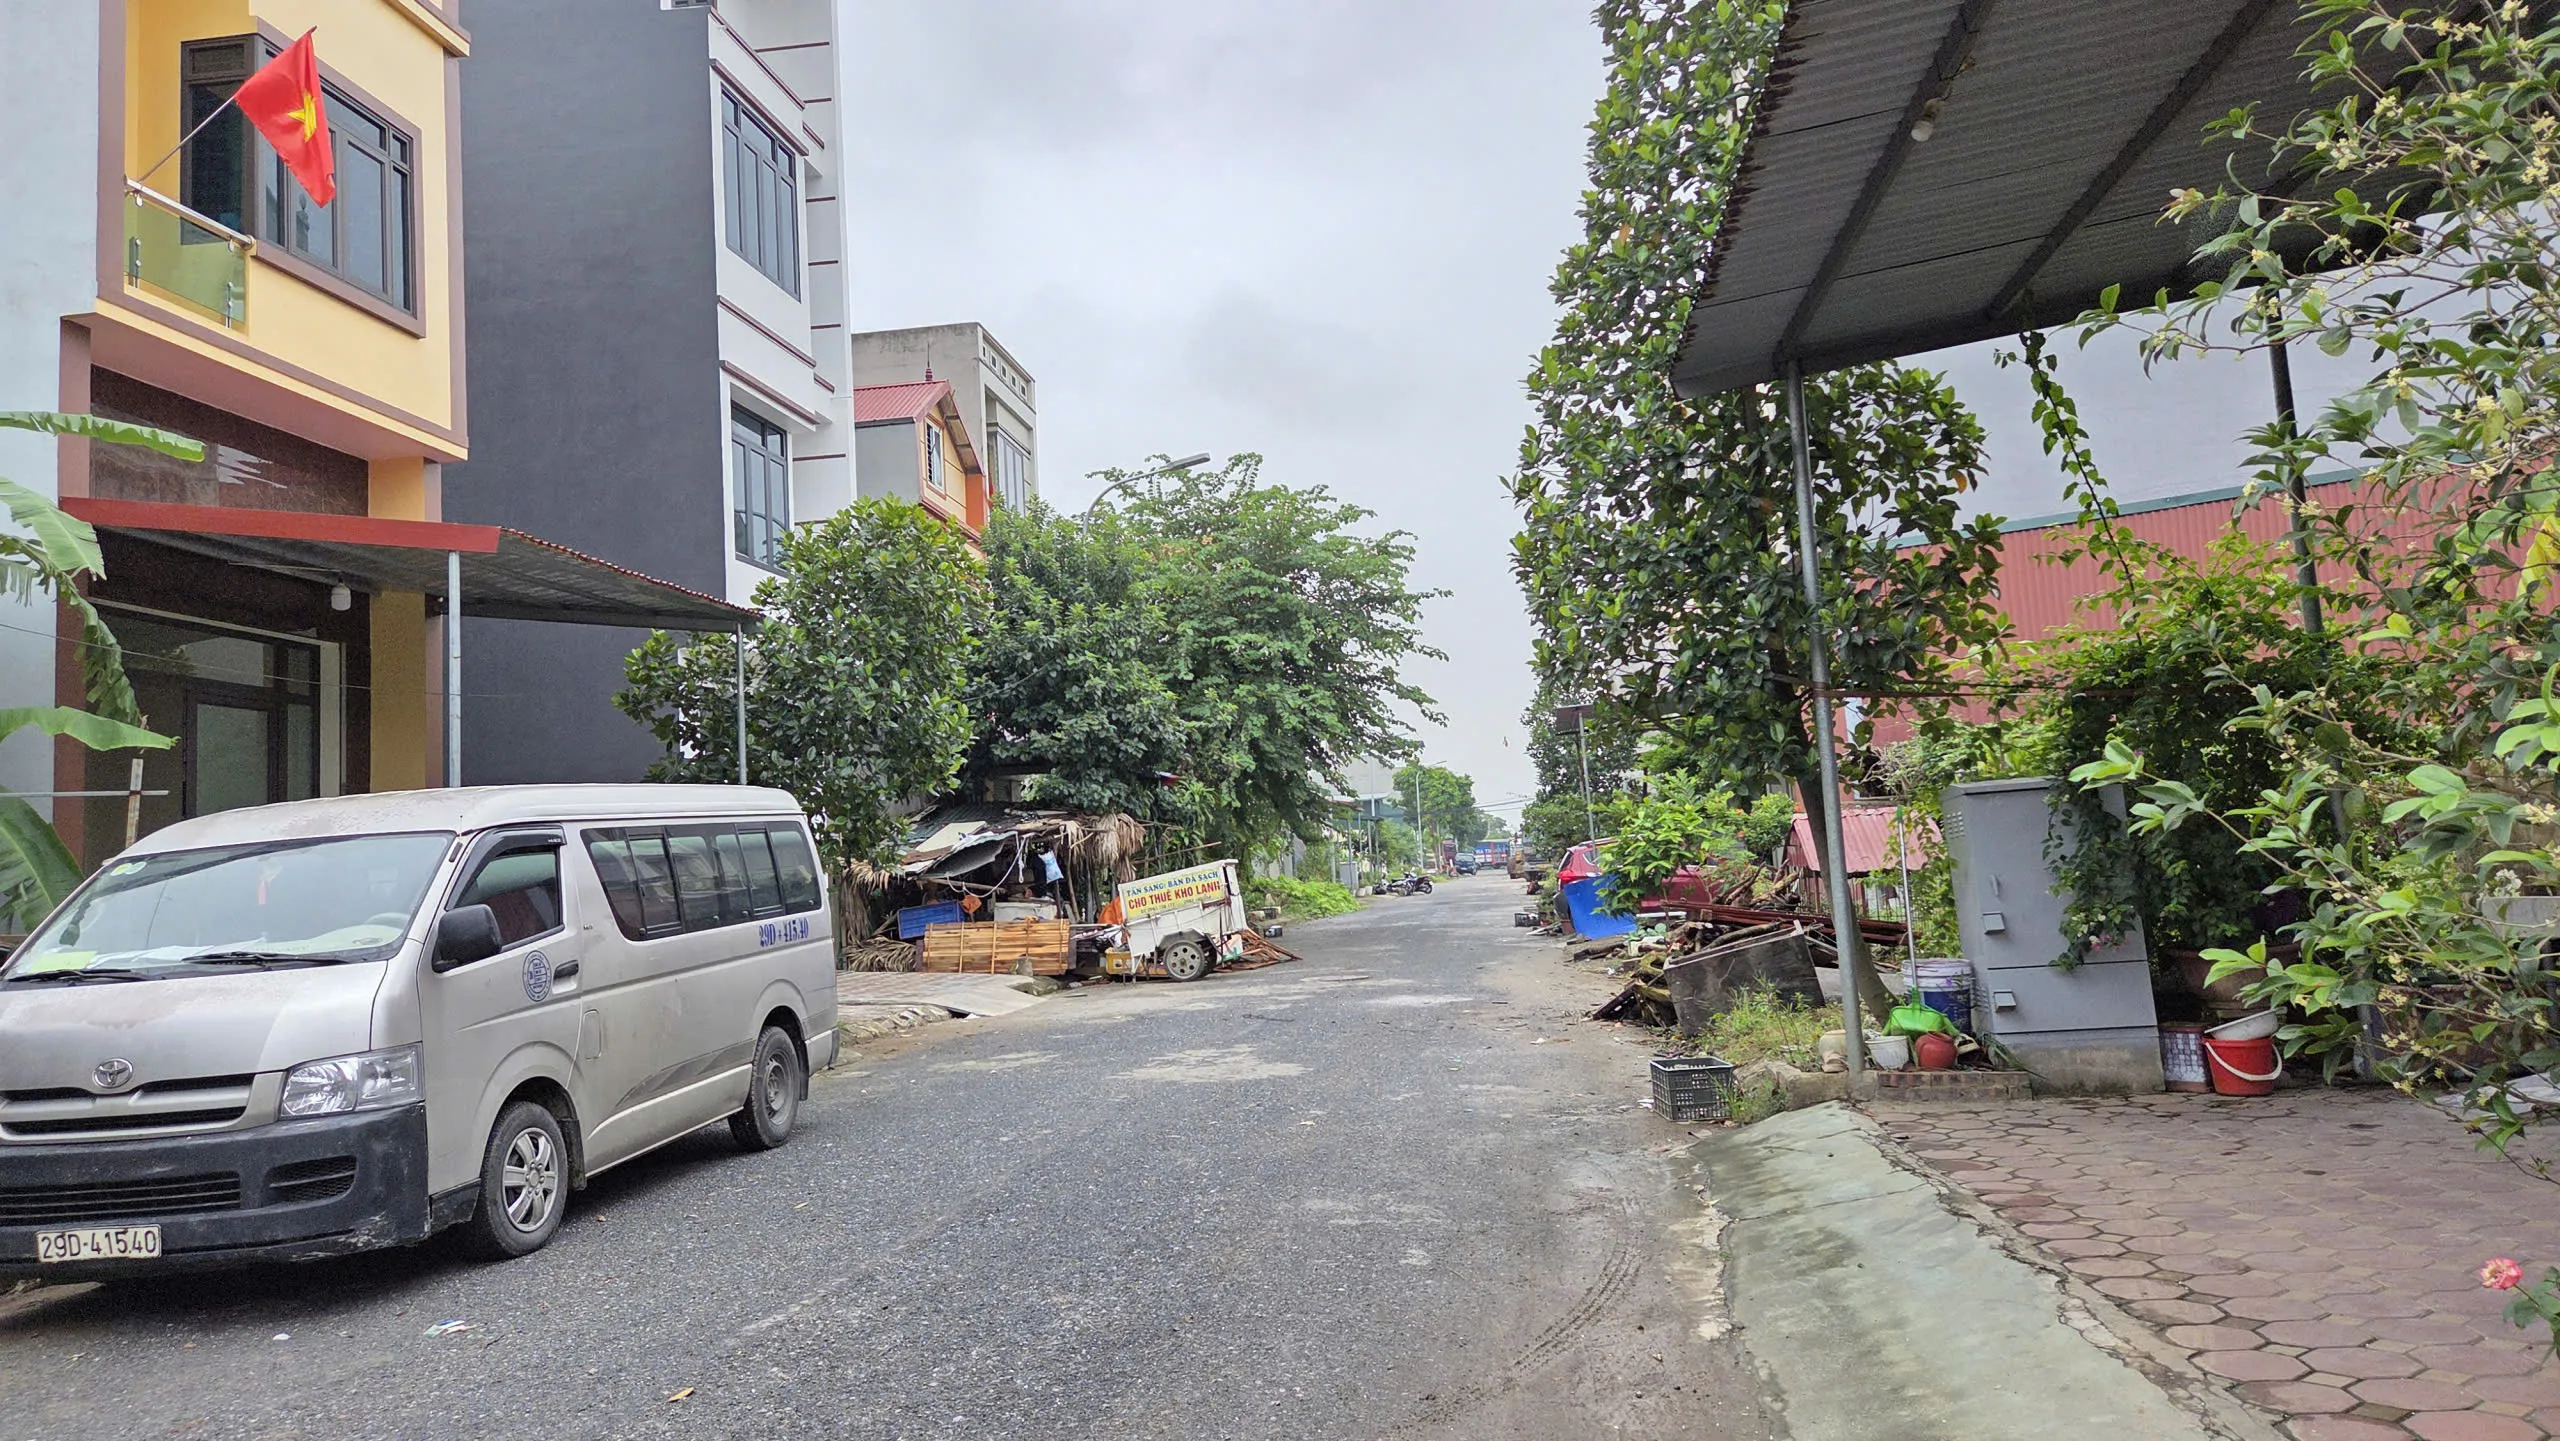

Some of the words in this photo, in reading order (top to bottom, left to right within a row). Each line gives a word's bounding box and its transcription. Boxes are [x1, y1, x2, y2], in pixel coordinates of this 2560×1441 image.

[1128, 896, 1147, 910] CHO
[1149, 888, 1173, 905] THUÊ
[1174, 886, 1194, 900] KHO
